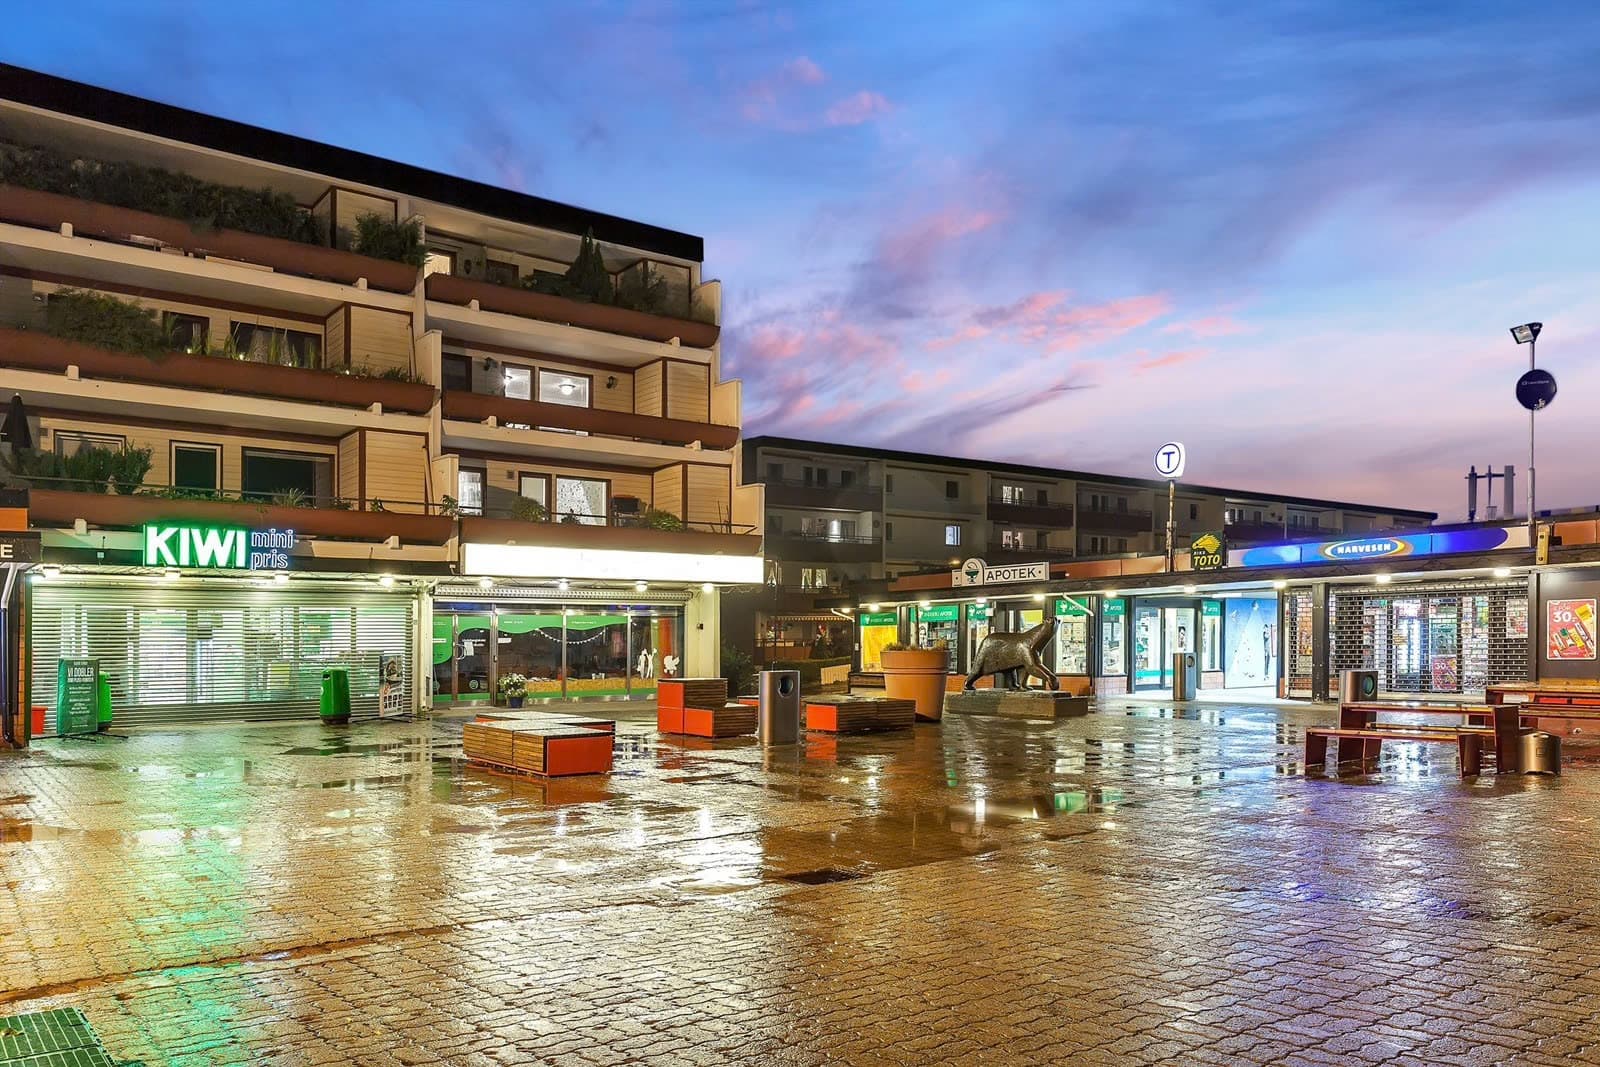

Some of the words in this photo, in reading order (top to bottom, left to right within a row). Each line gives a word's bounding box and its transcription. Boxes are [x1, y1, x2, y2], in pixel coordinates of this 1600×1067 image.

[1162, 451, 1175, 469] T
[146, 526, 247, 567] KIWI
[251, 528, 293, 549] mini
[1337, 543, 1391, 554] NARVESEN
[251, 549, 288, 570] pris
[1193, 554, 1221, 567] TOTO
[986, 567, 1037, 581] APOTEK
